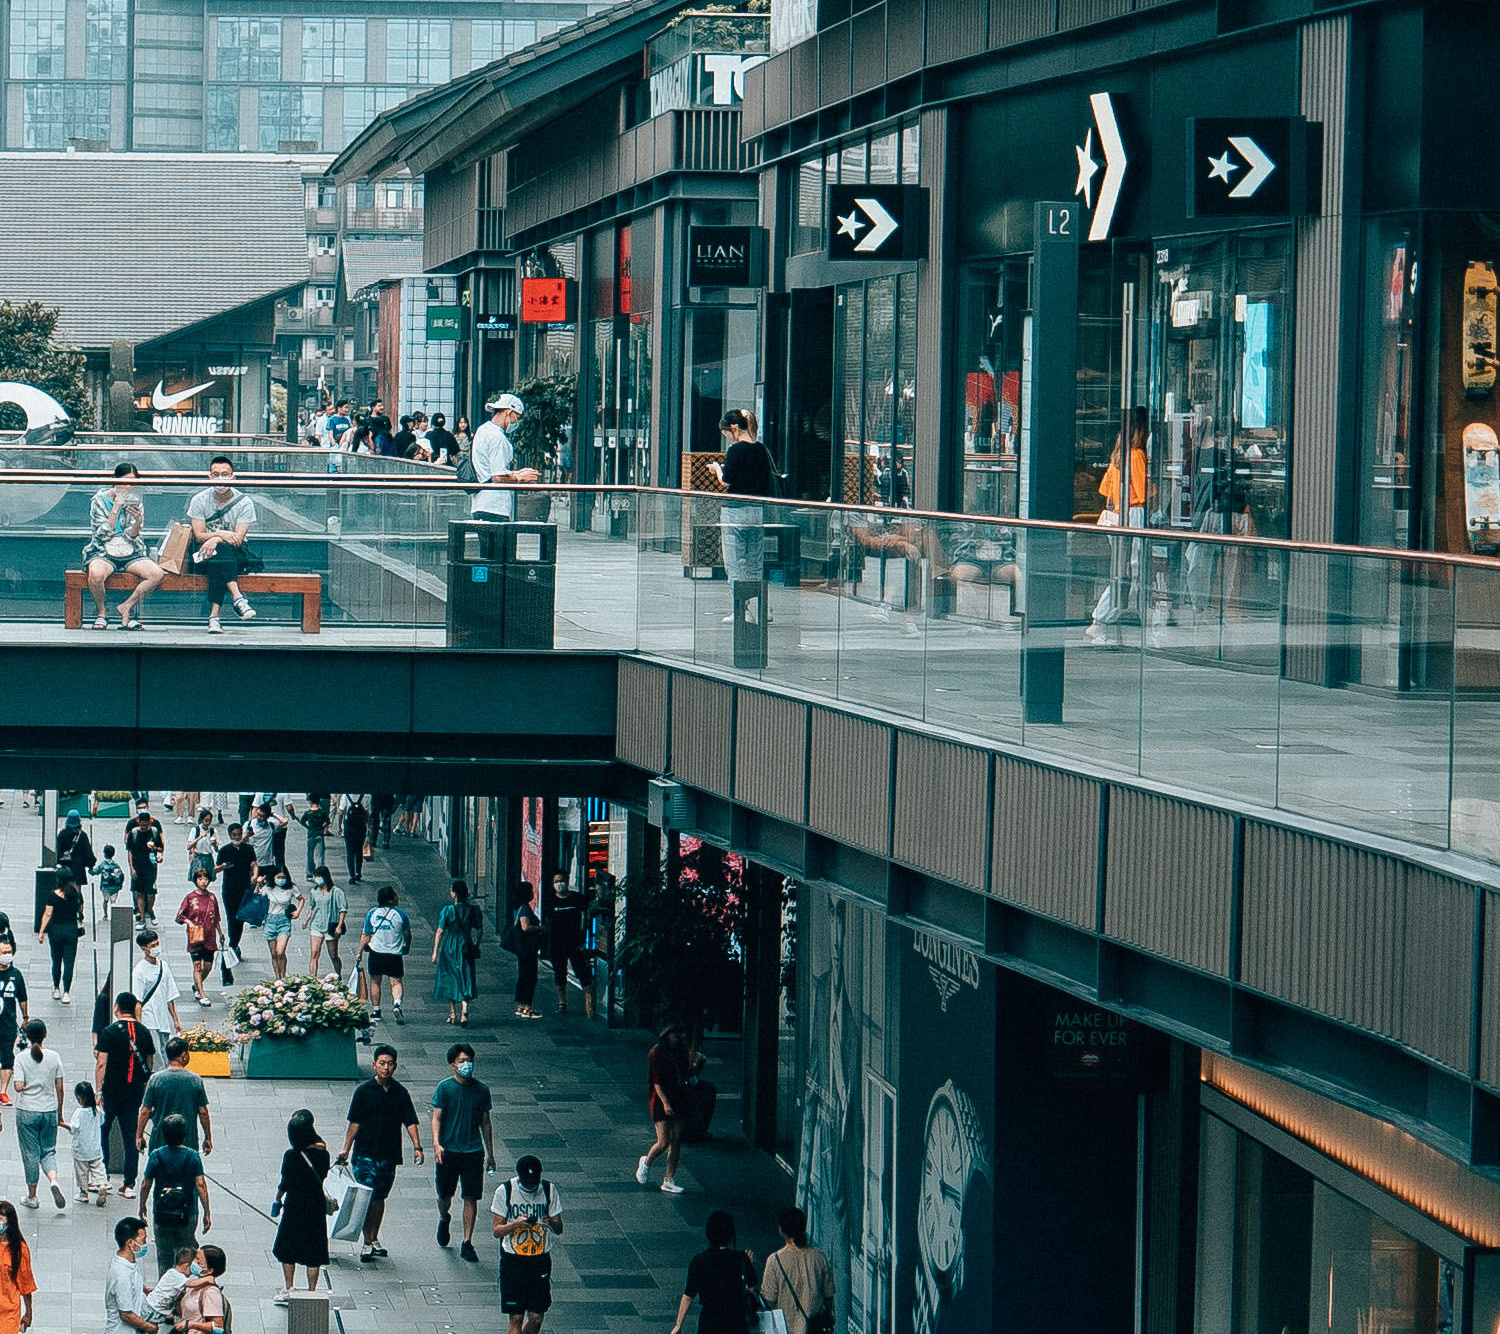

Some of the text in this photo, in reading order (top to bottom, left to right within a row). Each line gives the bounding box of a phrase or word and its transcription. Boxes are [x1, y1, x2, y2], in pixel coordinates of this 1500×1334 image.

[1049, 209, 1071, 235] L2
[697, 244, 744, 258] LIAN
[152, 415, 217, 434] RUNNING
[913, 929, 980, 990] LONGINES
[1055, 1012, 1102, 1028] MAKE
[1054, 1030, 1127, 1046] FOR EVER
